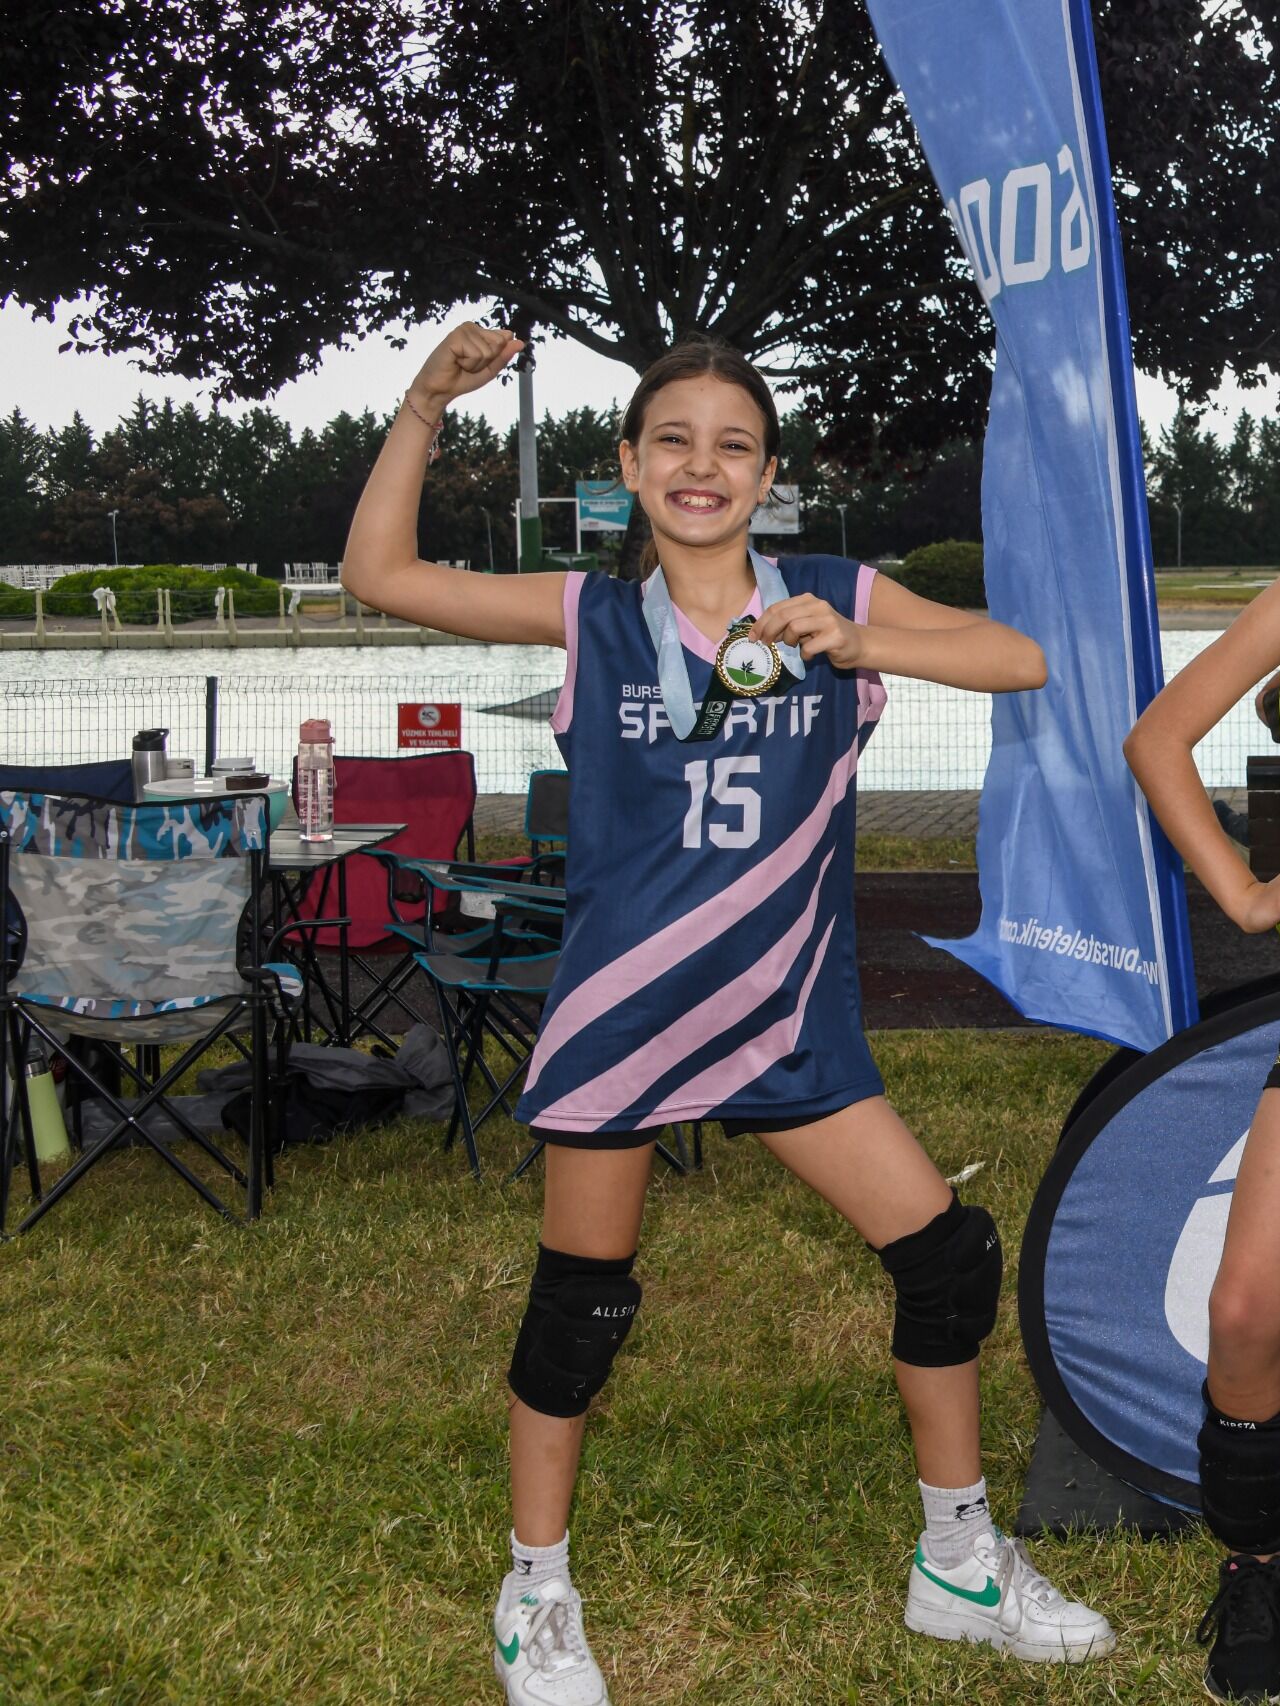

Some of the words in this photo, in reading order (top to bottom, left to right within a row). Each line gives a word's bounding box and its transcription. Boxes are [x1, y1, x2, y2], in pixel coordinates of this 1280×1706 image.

[622, 684, 662, 699] BURS
[409, 739, 417, 747] VE
[682, 755, 761, 849] 15
